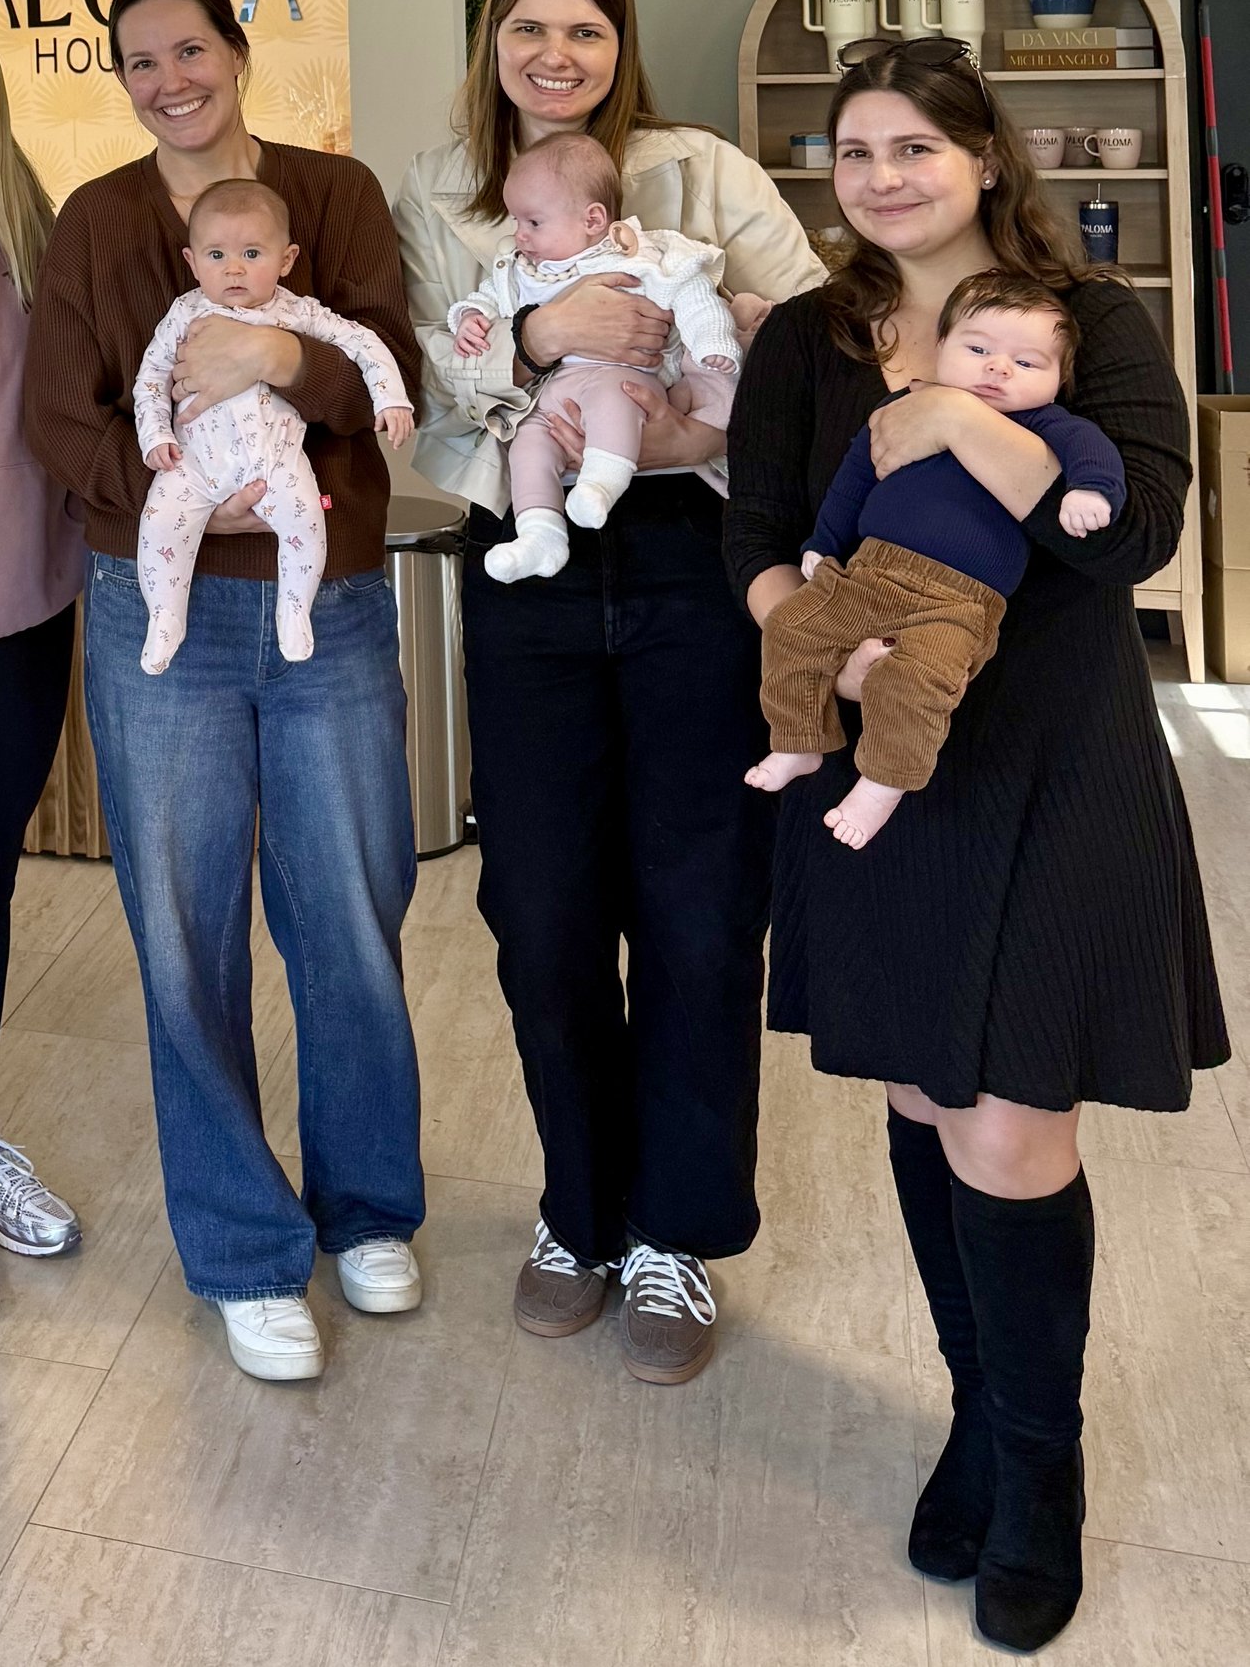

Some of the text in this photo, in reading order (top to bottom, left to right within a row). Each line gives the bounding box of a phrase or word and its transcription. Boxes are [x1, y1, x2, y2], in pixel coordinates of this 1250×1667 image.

[1022, 31, 1099, 47] DA VINCI
[1009, 53, 1111, 66] MICHELANGELO
[1099, 137, 1133, 147] PALOMA
[1081, 224, 1114, 234] PALOMA
